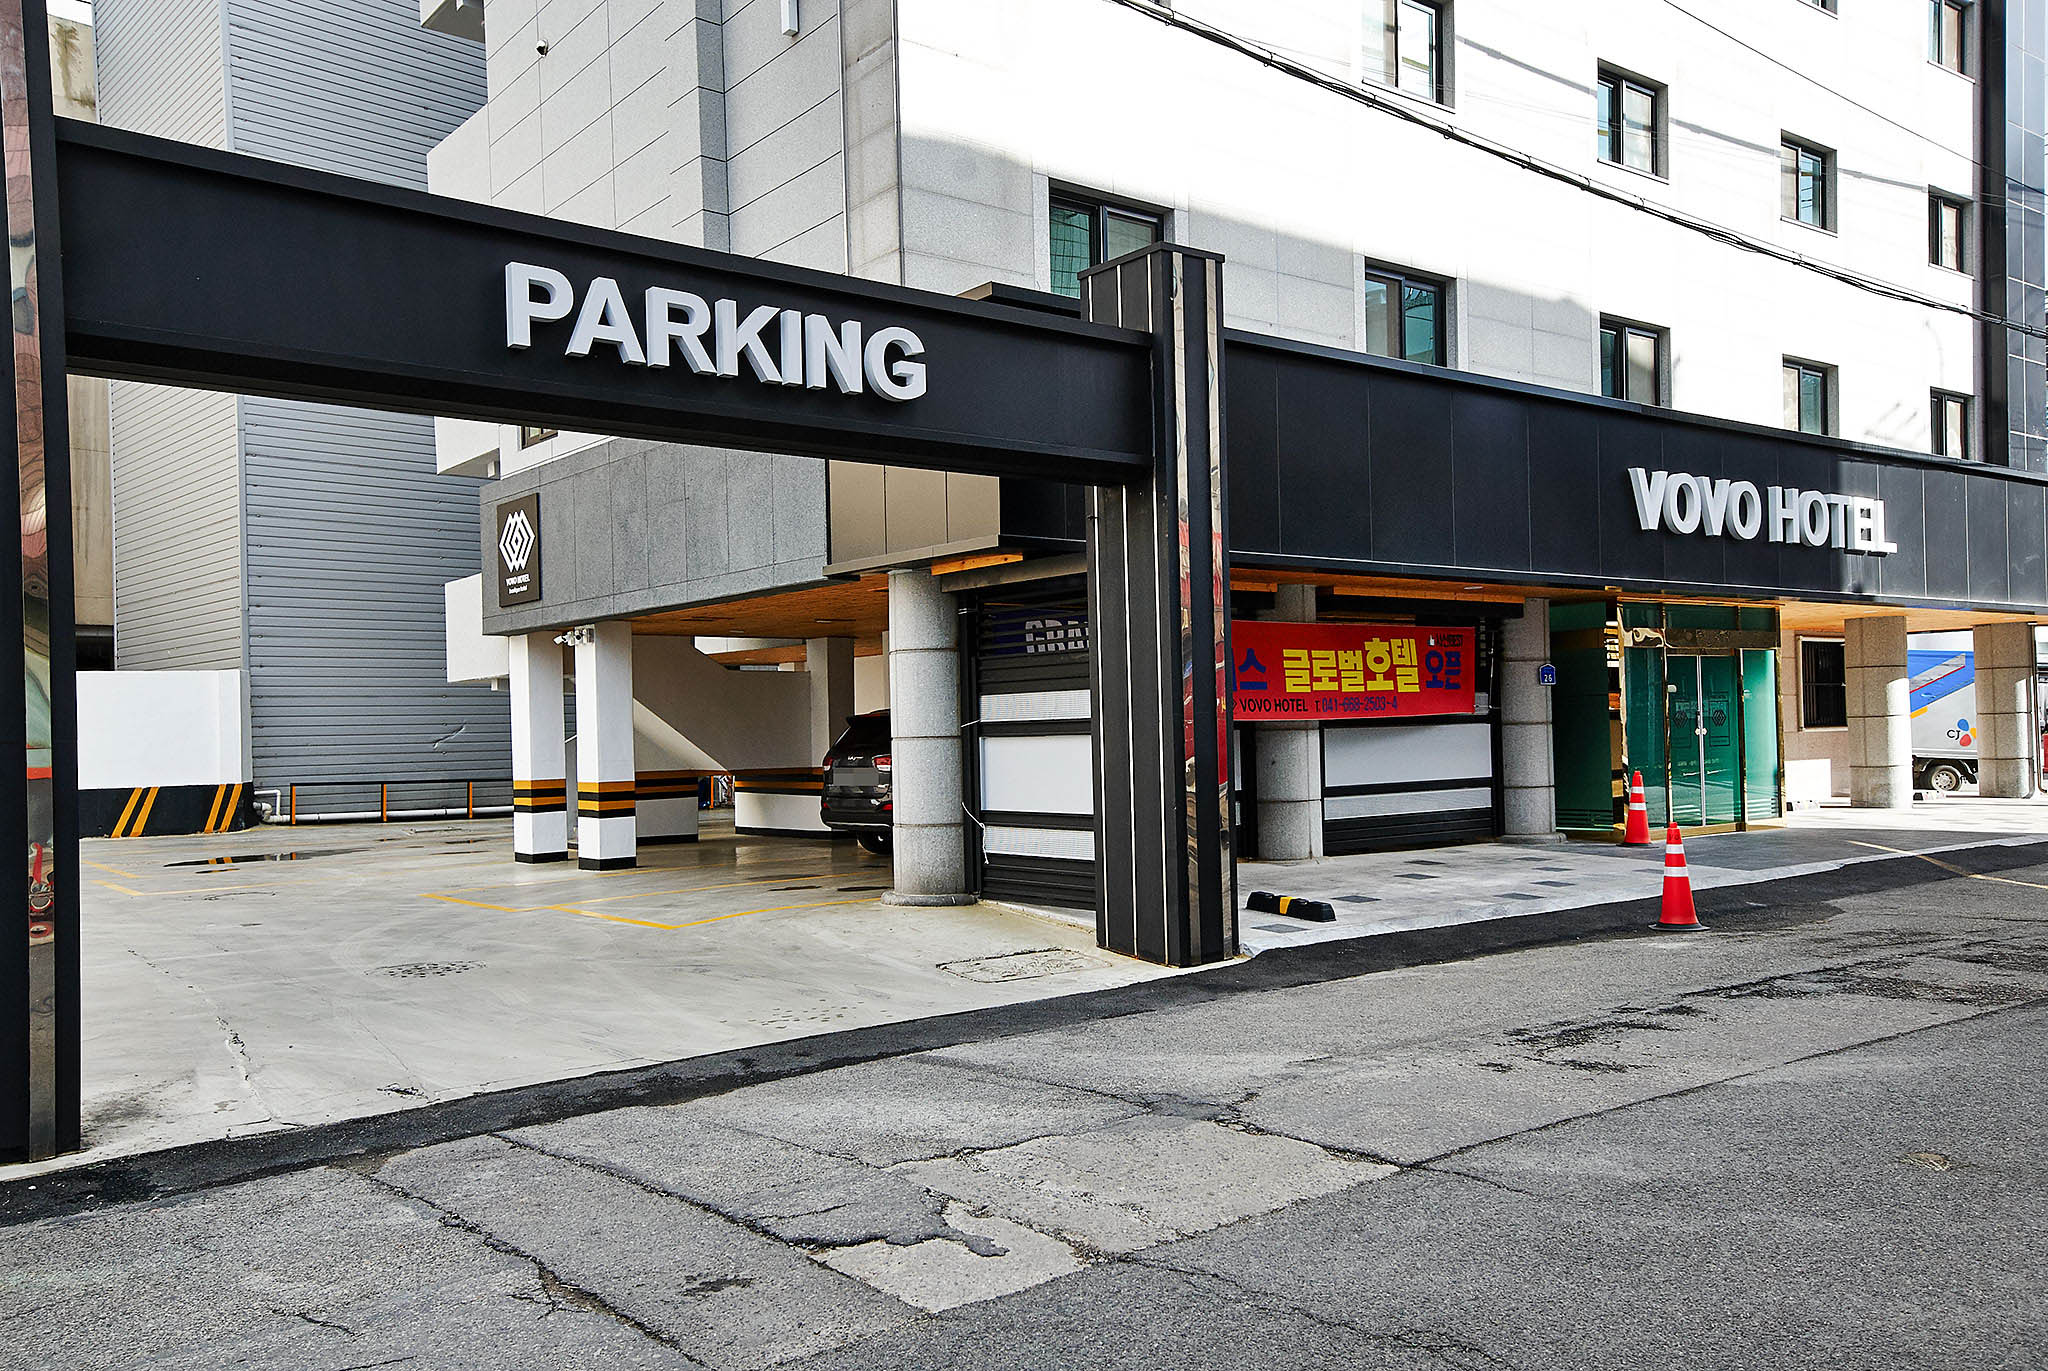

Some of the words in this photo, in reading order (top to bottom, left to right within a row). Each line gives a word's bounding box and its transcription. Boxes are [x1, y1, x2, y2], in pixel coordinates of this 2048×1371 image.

[505, 261, 927, 402] PARKING
[1627, 467, 1762, 541] VOVO
[1767, 485, 1898, 555] HOTEL
[1283, 637, 1420, 693] 글로벌호텔
[1241, 699, 1272, 713] VOVO
[1274, 698, 1308, 713] HOTEL
[1946, 729, 1960, 740] CJ
